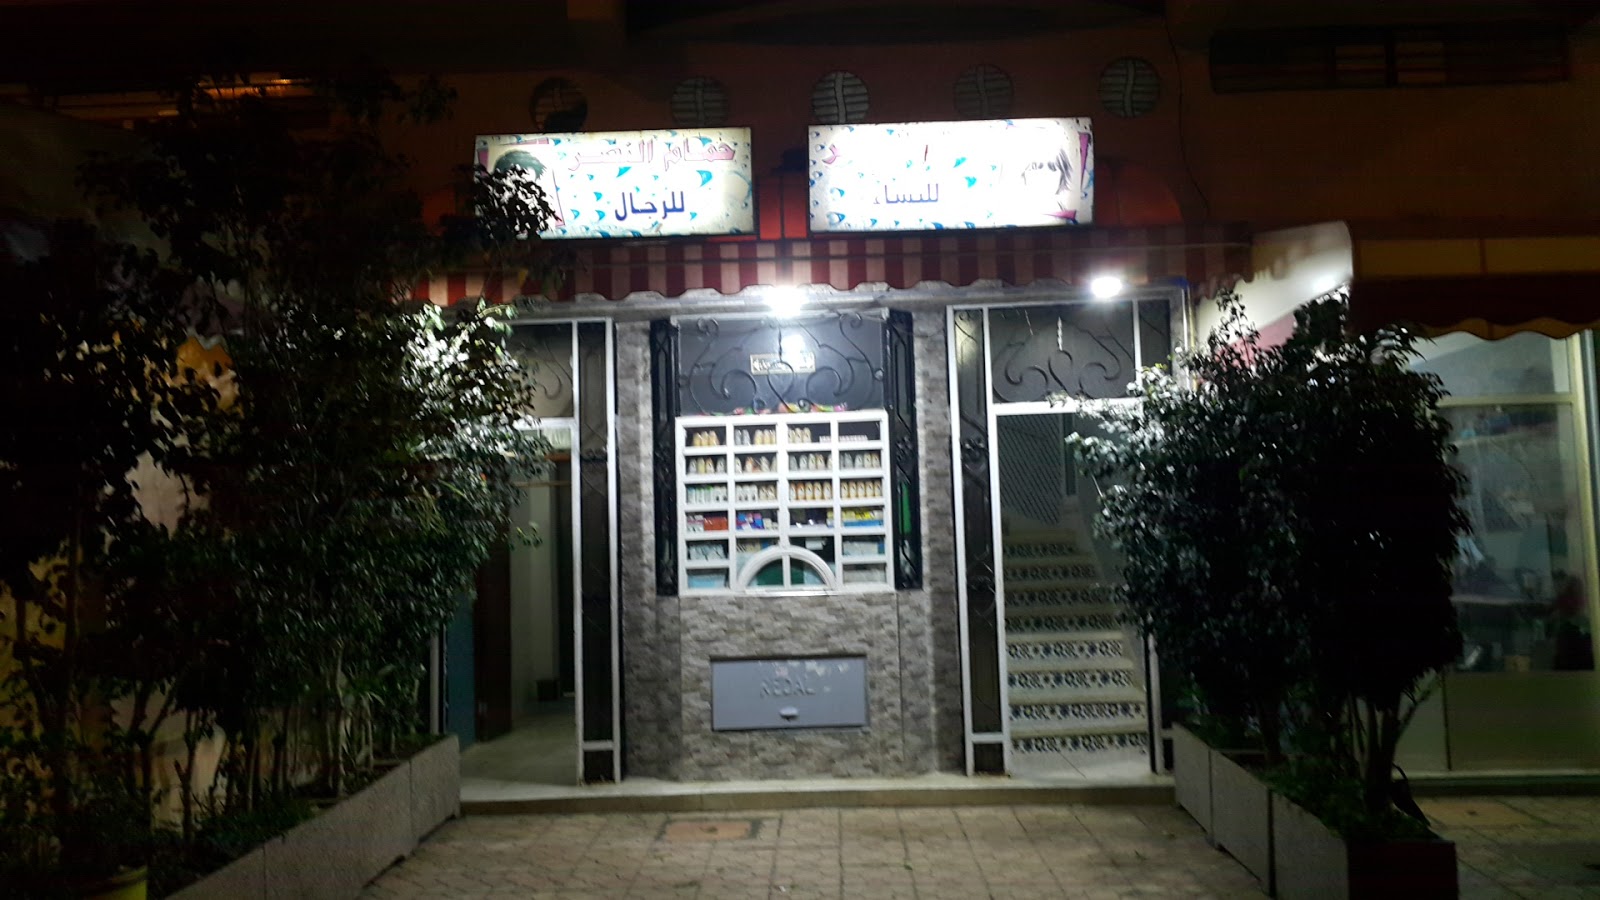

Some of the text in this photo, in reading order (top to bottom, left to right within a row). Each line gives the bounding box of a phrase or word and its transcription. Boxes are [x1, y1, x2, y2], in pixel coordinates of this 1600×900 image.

[567, 138, 736, 172] حمام النصر
[614, 190, 685, 221] للرجال
